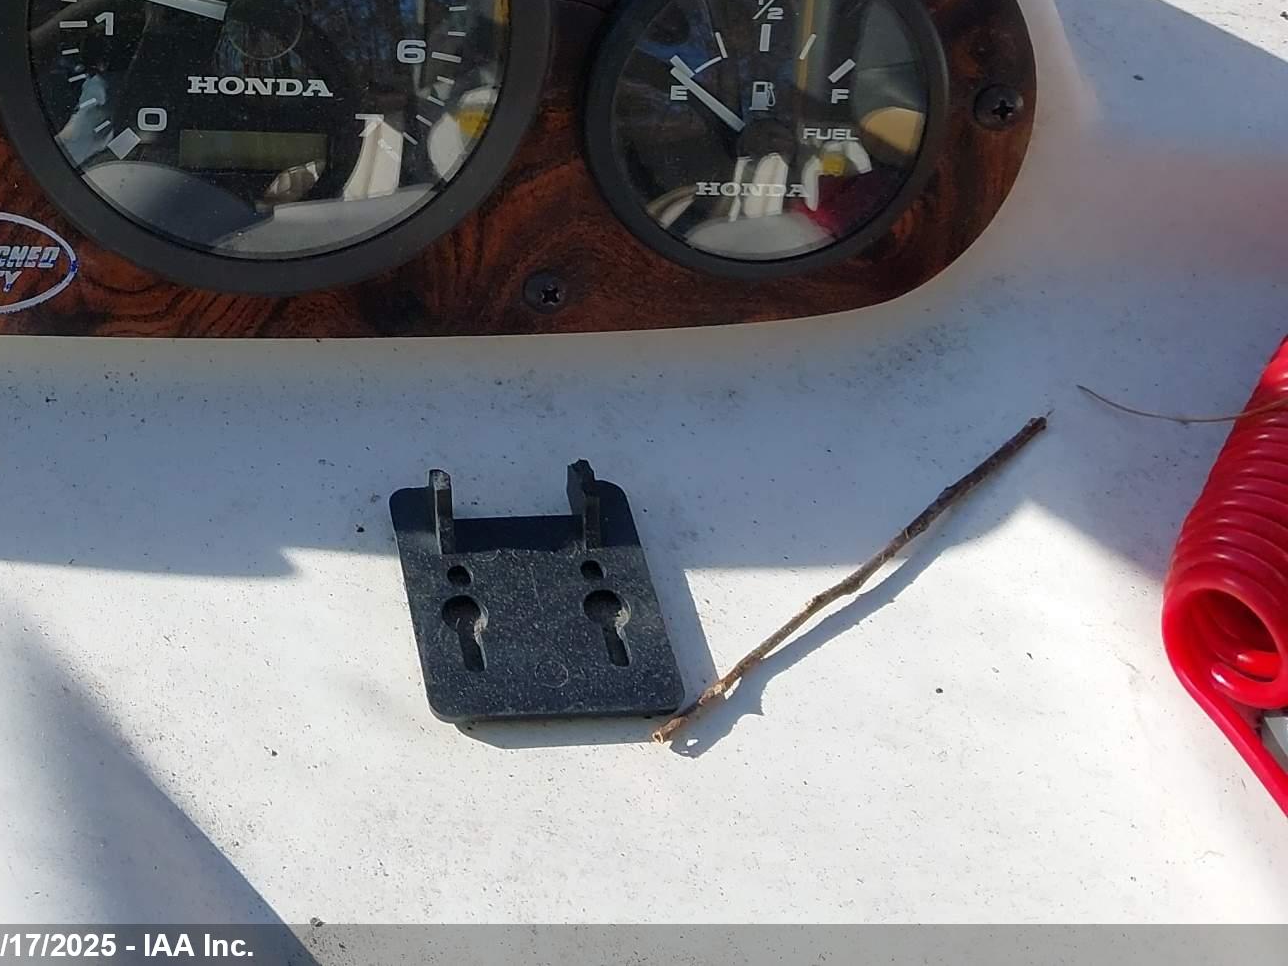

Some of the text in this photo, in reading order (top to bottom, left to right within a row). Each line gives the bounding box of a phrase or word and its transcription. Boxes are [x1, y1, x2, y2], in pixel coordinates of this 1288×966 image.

[96, 13, 114, 35] 1
[396, 39, 427, 63] 6
[187, 76, 334, 97] HONDA
[669, 85, 689, 101] E
[831, 89, 850, 104] F
[137, 108, 168, 131] 0
[803, 128, 860, 141] FUEL
[695, 181, 811, 198] HONDA
